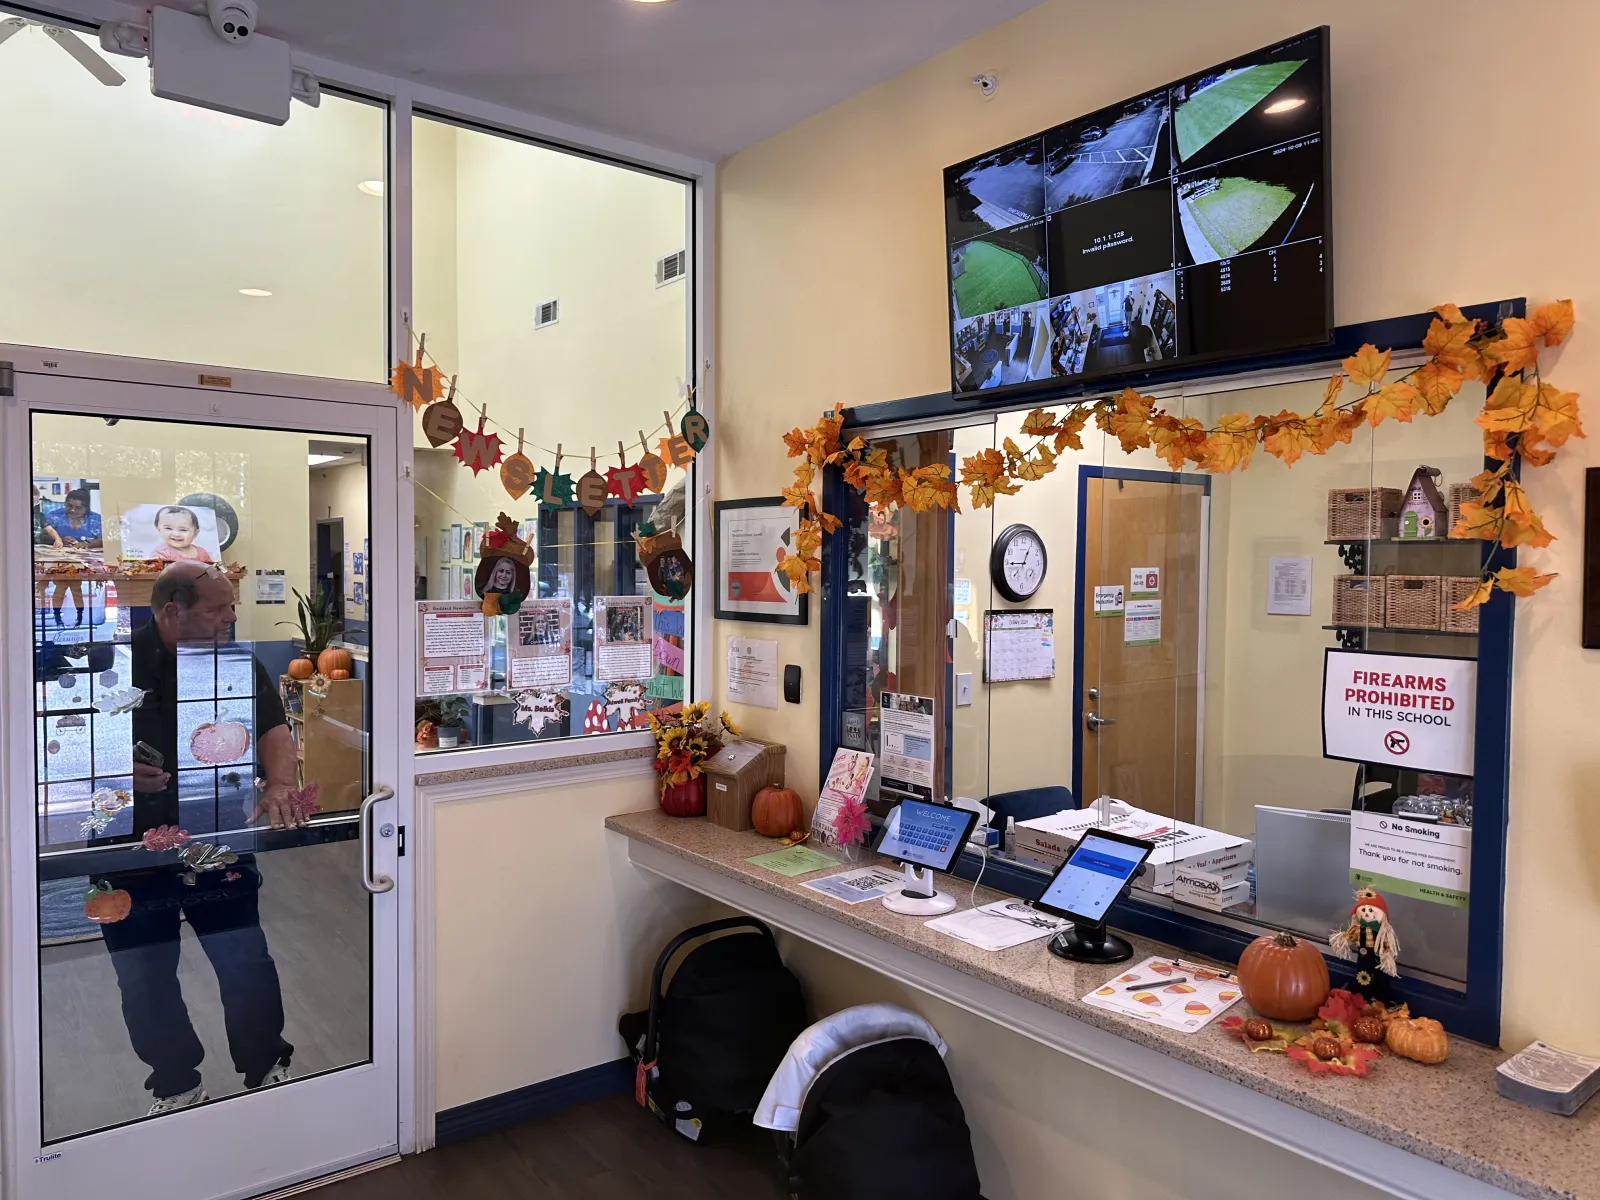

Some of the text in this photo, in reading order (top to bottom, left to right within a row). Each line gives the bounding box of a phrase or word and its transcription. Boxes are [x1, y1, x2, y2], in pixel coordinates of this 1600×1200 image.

[1093, 230, 1125, 244] 10.1.1.128
[1352, 670, 1447, 692] FIREARMS
[1344, 687, 1455, 712] PROHIBITED
[520, 704, 555, 713] Ms. Belkis
[1348, 706, 1452, 727] IN THIS SCHOOL
[916, 808, 952, 823] WELCOME
[1391, 822, 1441, 840] No Smoking
[1035, 838, 1061, 852] Salads
[1196, 853, 1237, 869] Veal Appetizers
[1358, 847, 1463, 876] Thank you for not smoking.
[1419, 887, 1440, 897] HEALTH
[1445, 892, 1467, 902] SAFETY
[39, 1153, 62, 1163] Trulite
